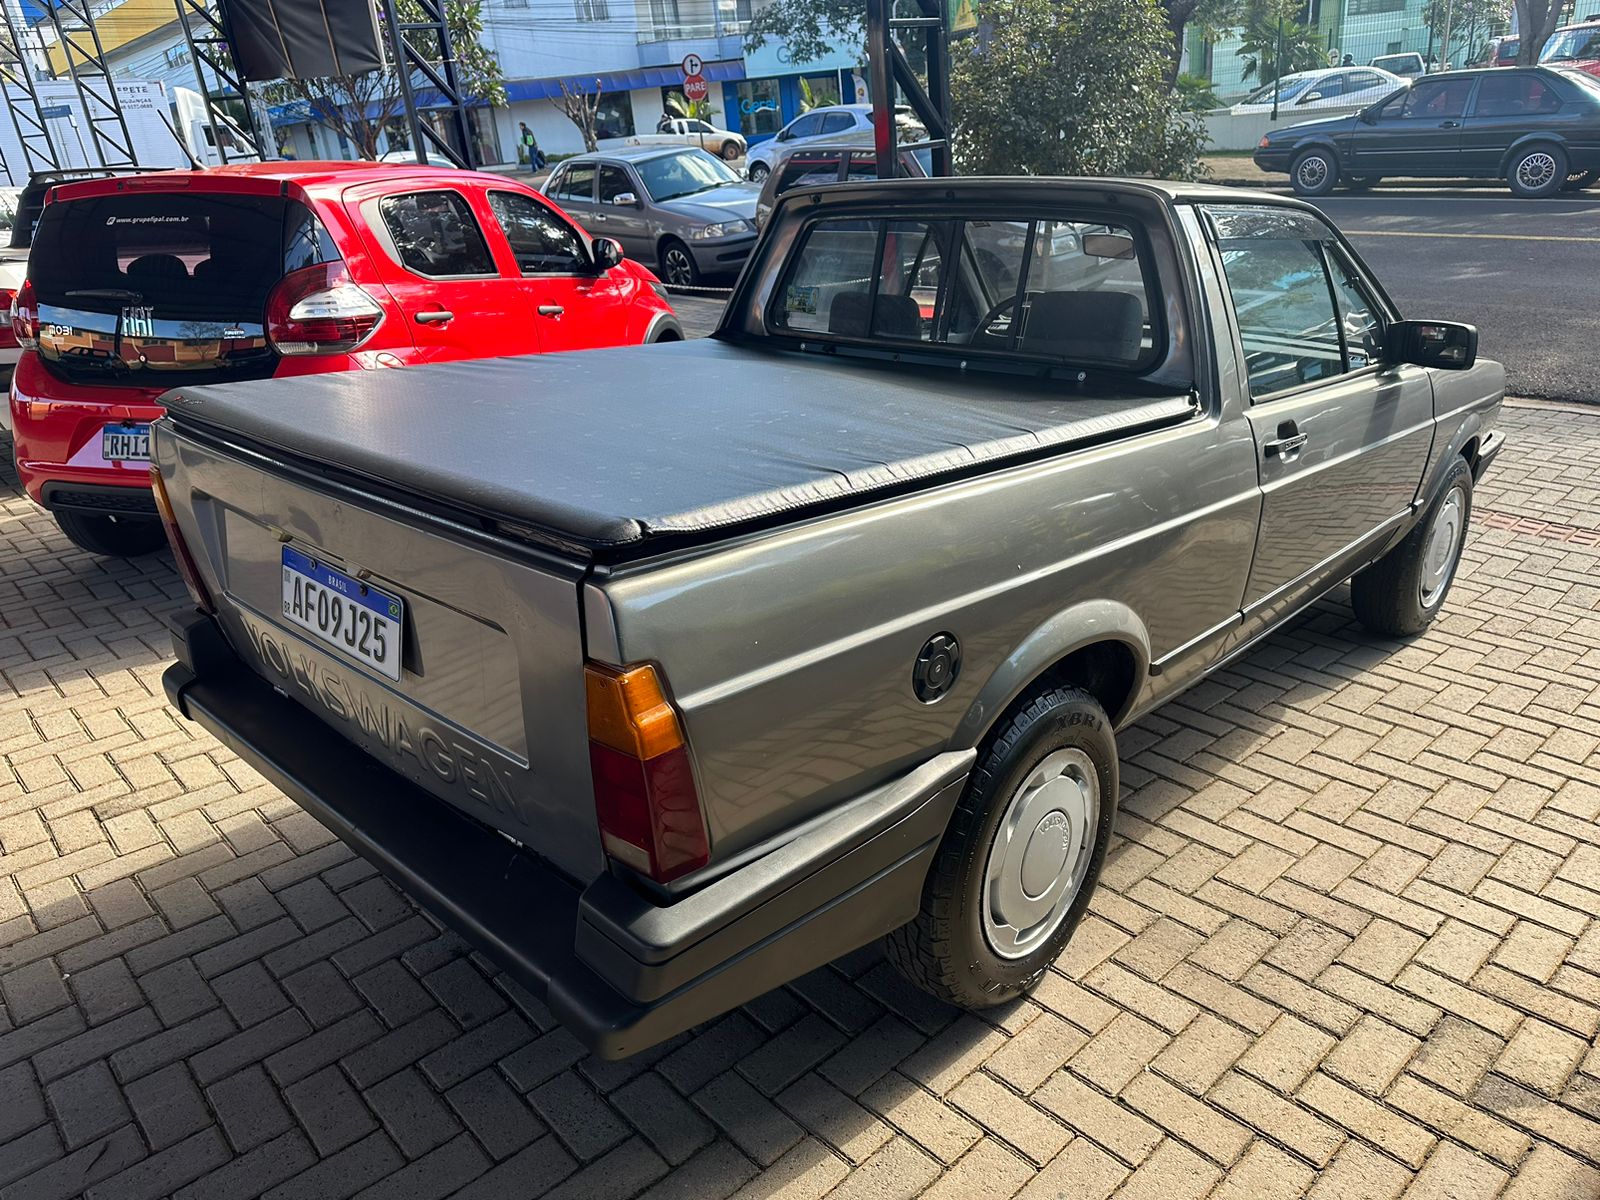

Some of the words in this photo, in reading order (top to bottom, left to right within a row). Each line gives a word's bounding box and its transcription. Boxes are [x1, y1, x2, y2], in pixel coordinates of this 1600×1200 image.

[685, 82, 707, 92] PARE
[741, 99, 776, 114] Geral
[120, 306, 154, 337] FIAT
[49, 324, 73, 336] MOBI
[328, 575, 348, 593] BRASIL
[239, 614, 529, 827] VOLKSWAGEN
